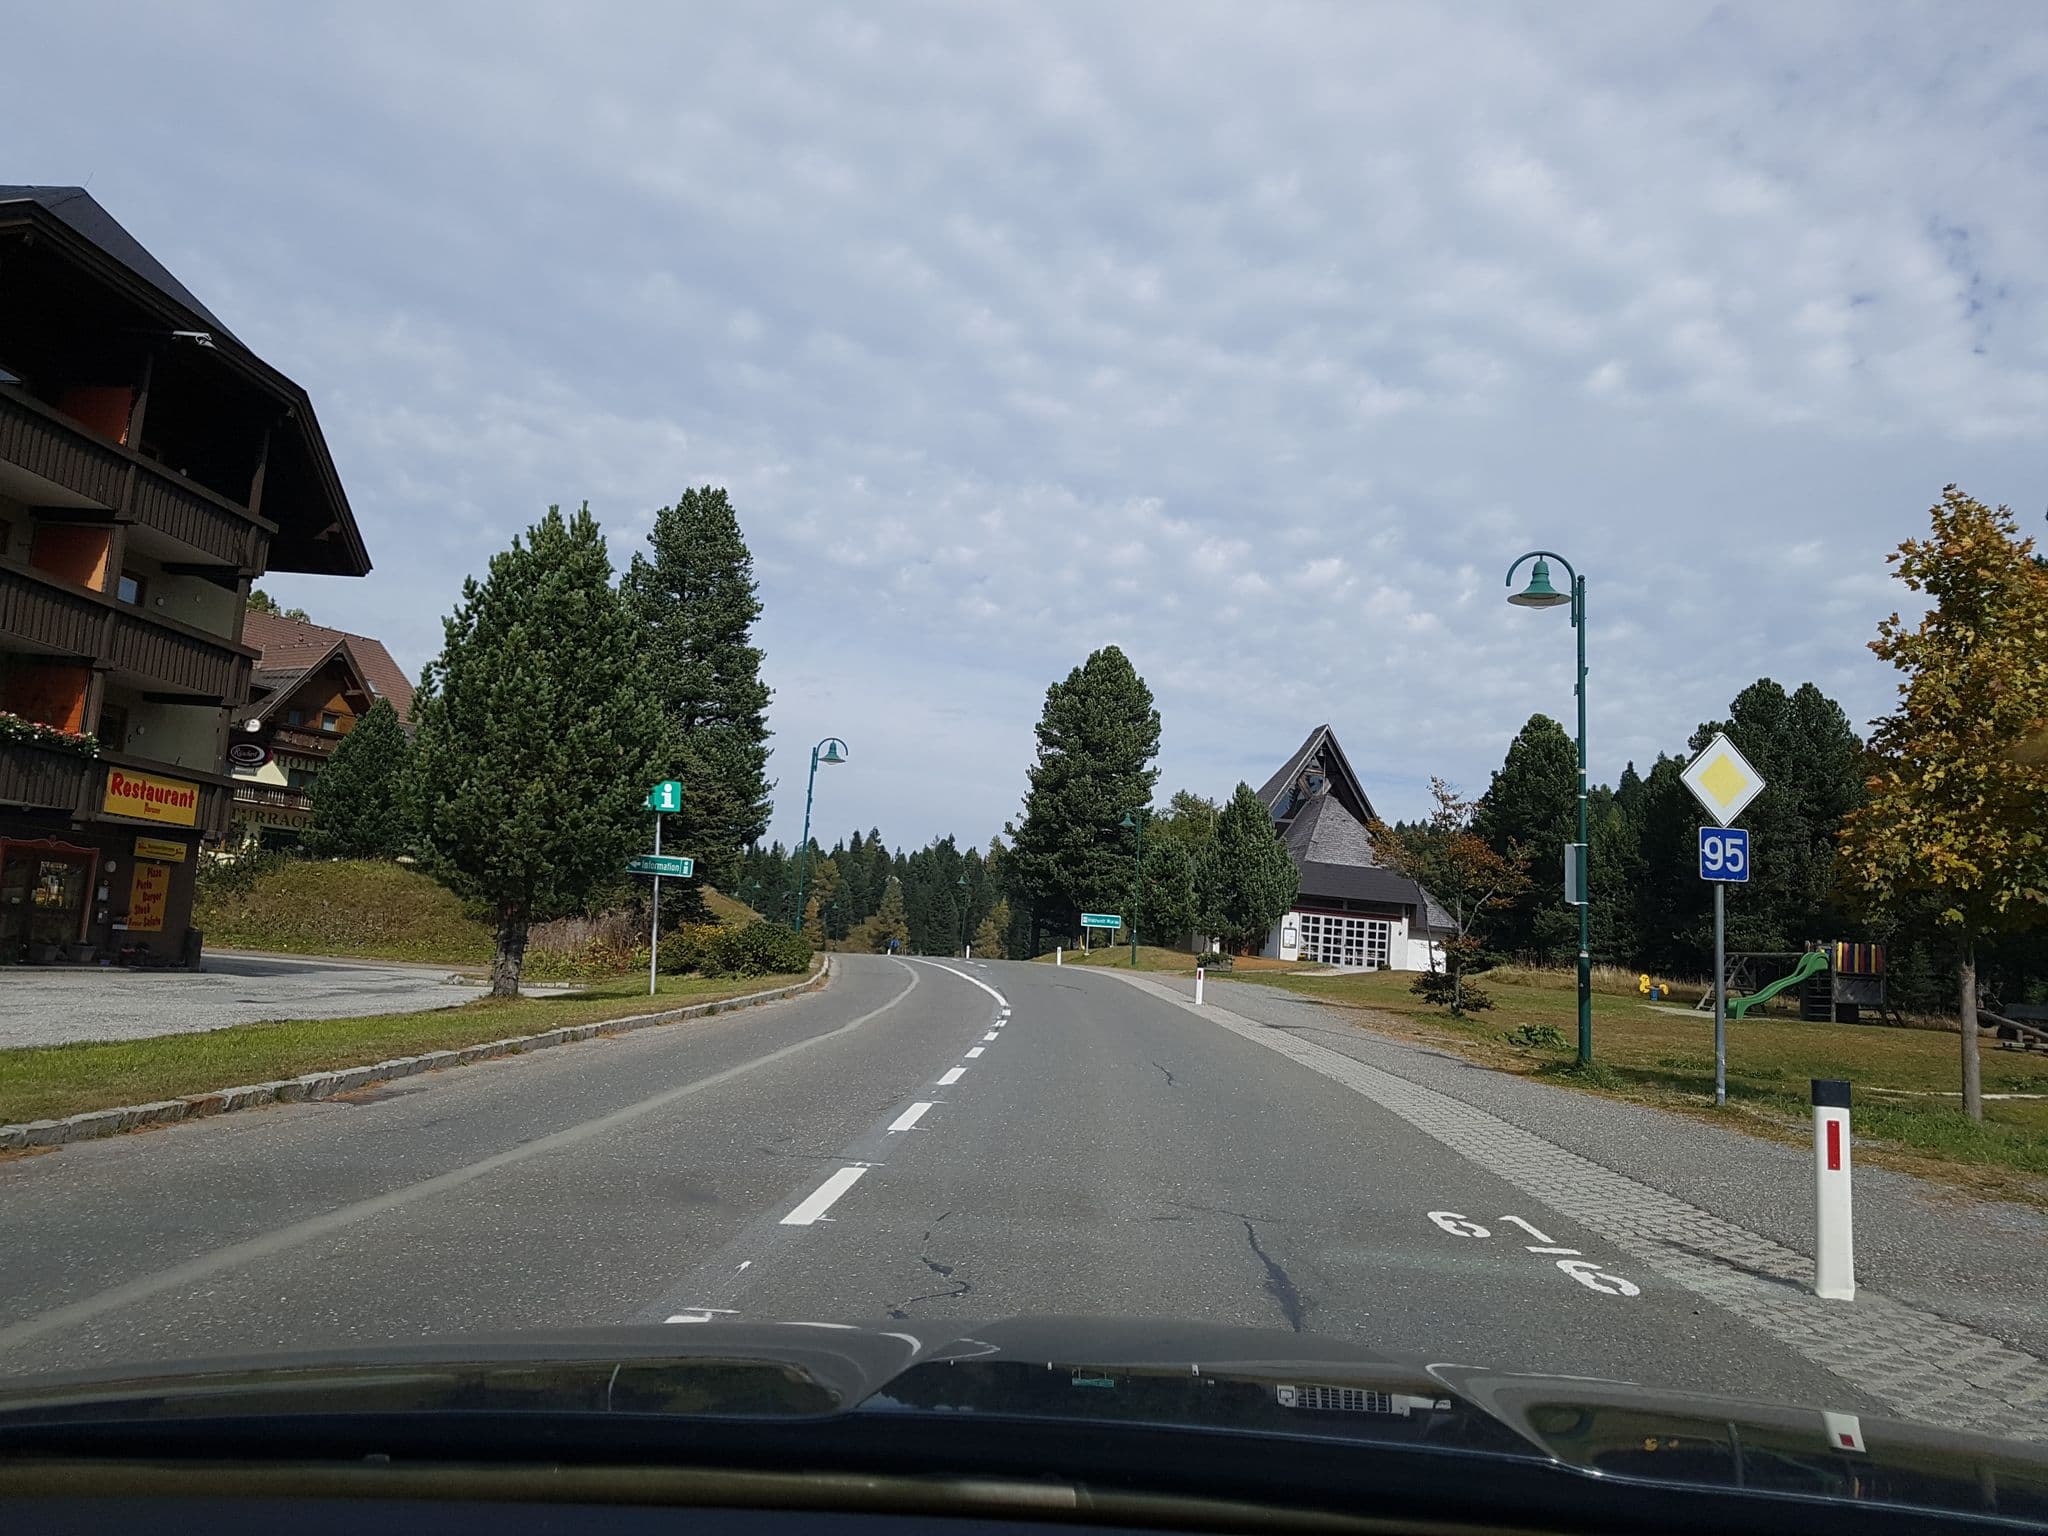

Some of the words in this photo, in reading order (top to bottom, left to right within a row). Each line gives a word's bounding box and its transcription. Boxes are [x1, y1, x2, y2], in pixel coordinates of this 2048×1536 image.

[110, 772, 195, 809] Restaurant
[641, 860, 680, 873] Information
[1704, 837, 1744, 872] 95
